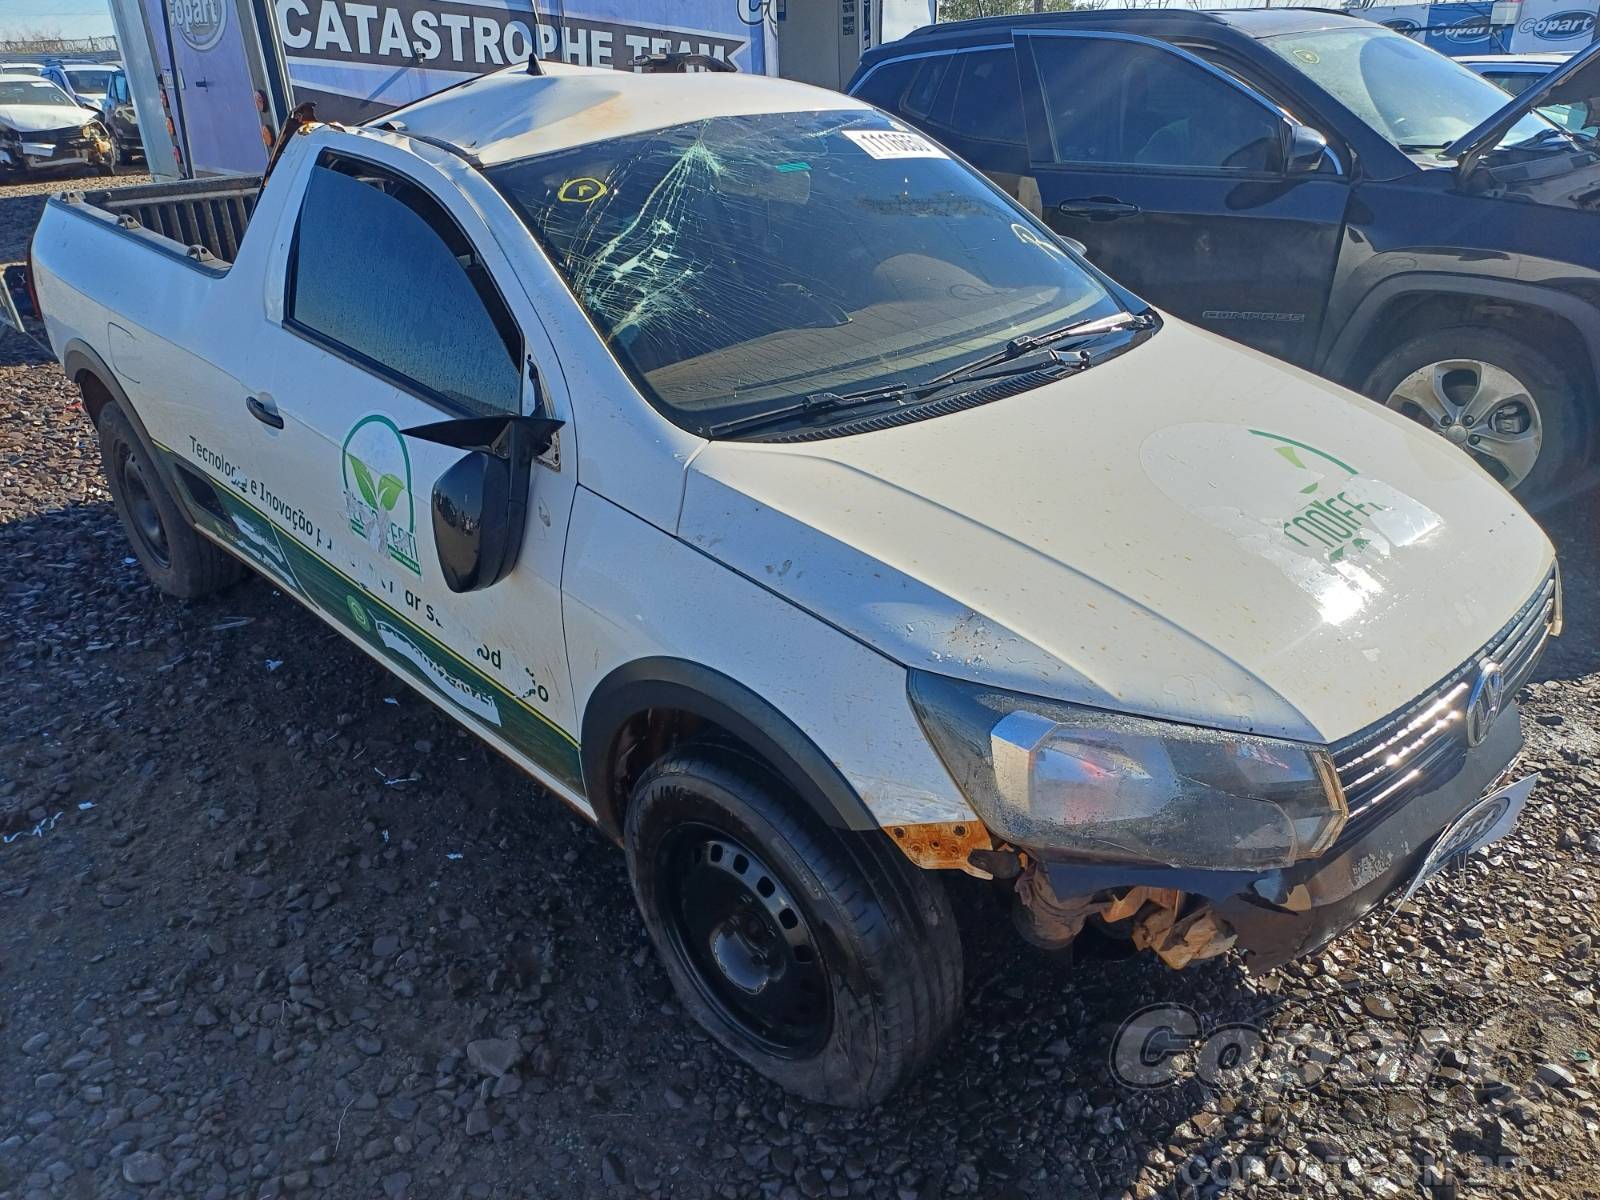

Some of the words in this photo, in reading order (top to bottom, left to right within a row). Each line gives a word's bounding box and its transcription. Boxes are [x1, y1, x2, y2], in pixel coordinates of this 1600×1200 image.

[276, 0, 613, 72] CATASTROPHE
[1519, 17, 1592, 35] Copart
[188, 434, 248, 493] Tecnolo
[250, 480, 257, 495] e
[260, 482, 313, 536] Inovação
